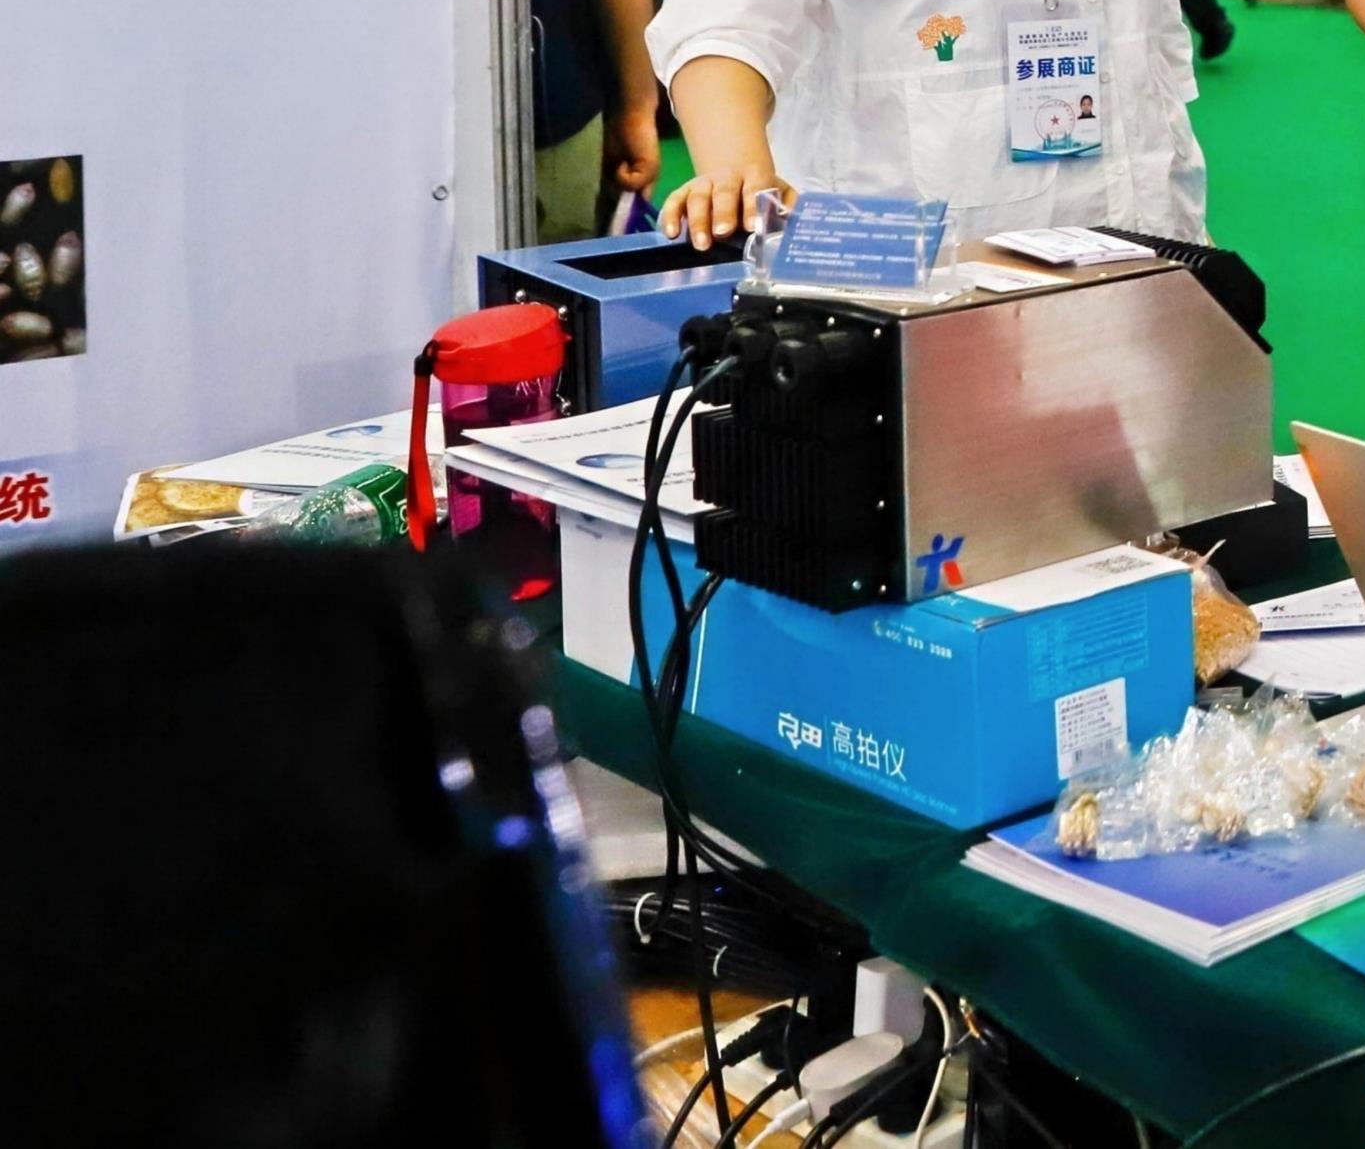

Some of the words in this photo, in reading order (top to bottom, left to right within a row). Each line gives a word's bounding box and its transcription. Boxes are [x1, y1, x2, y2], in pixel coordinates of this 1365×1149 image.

[1016, 55, 1096, 81] 参展商证
[831, 721, 907, 782] 高拍仪
